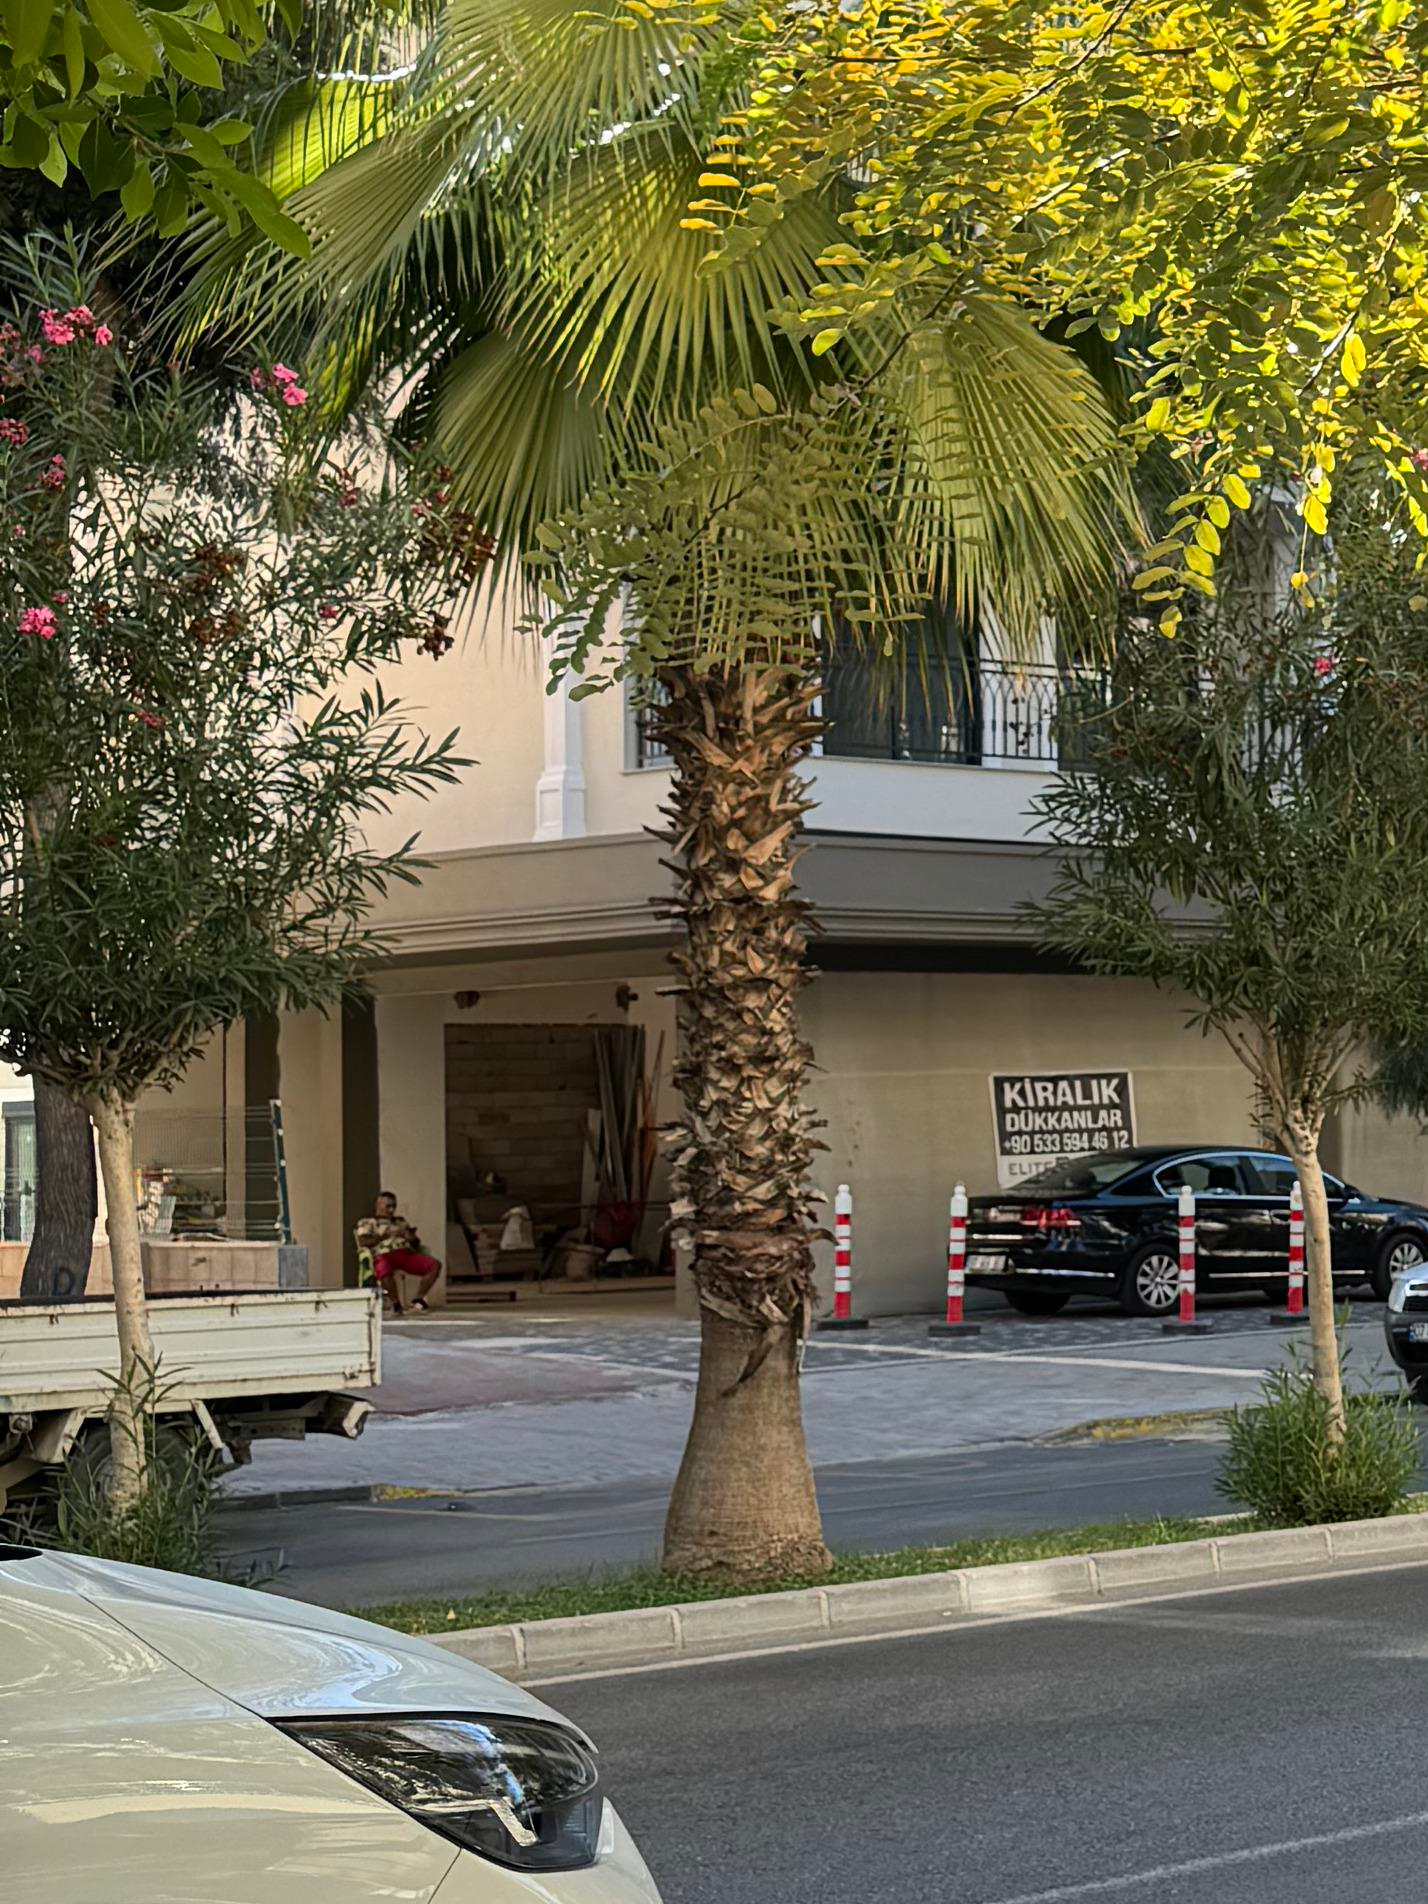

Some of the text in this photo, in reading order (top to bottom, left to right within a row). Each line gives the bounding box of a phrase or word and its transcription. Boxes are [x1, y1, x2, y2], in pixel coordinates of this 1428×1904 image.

[1002, 1078, 1120, 1108] KİRALIK
[1005, 1109, 1123, 1132] DÜKKANLAR
[1003, 1130, 1130, 1153] +90 533 594 46 12
